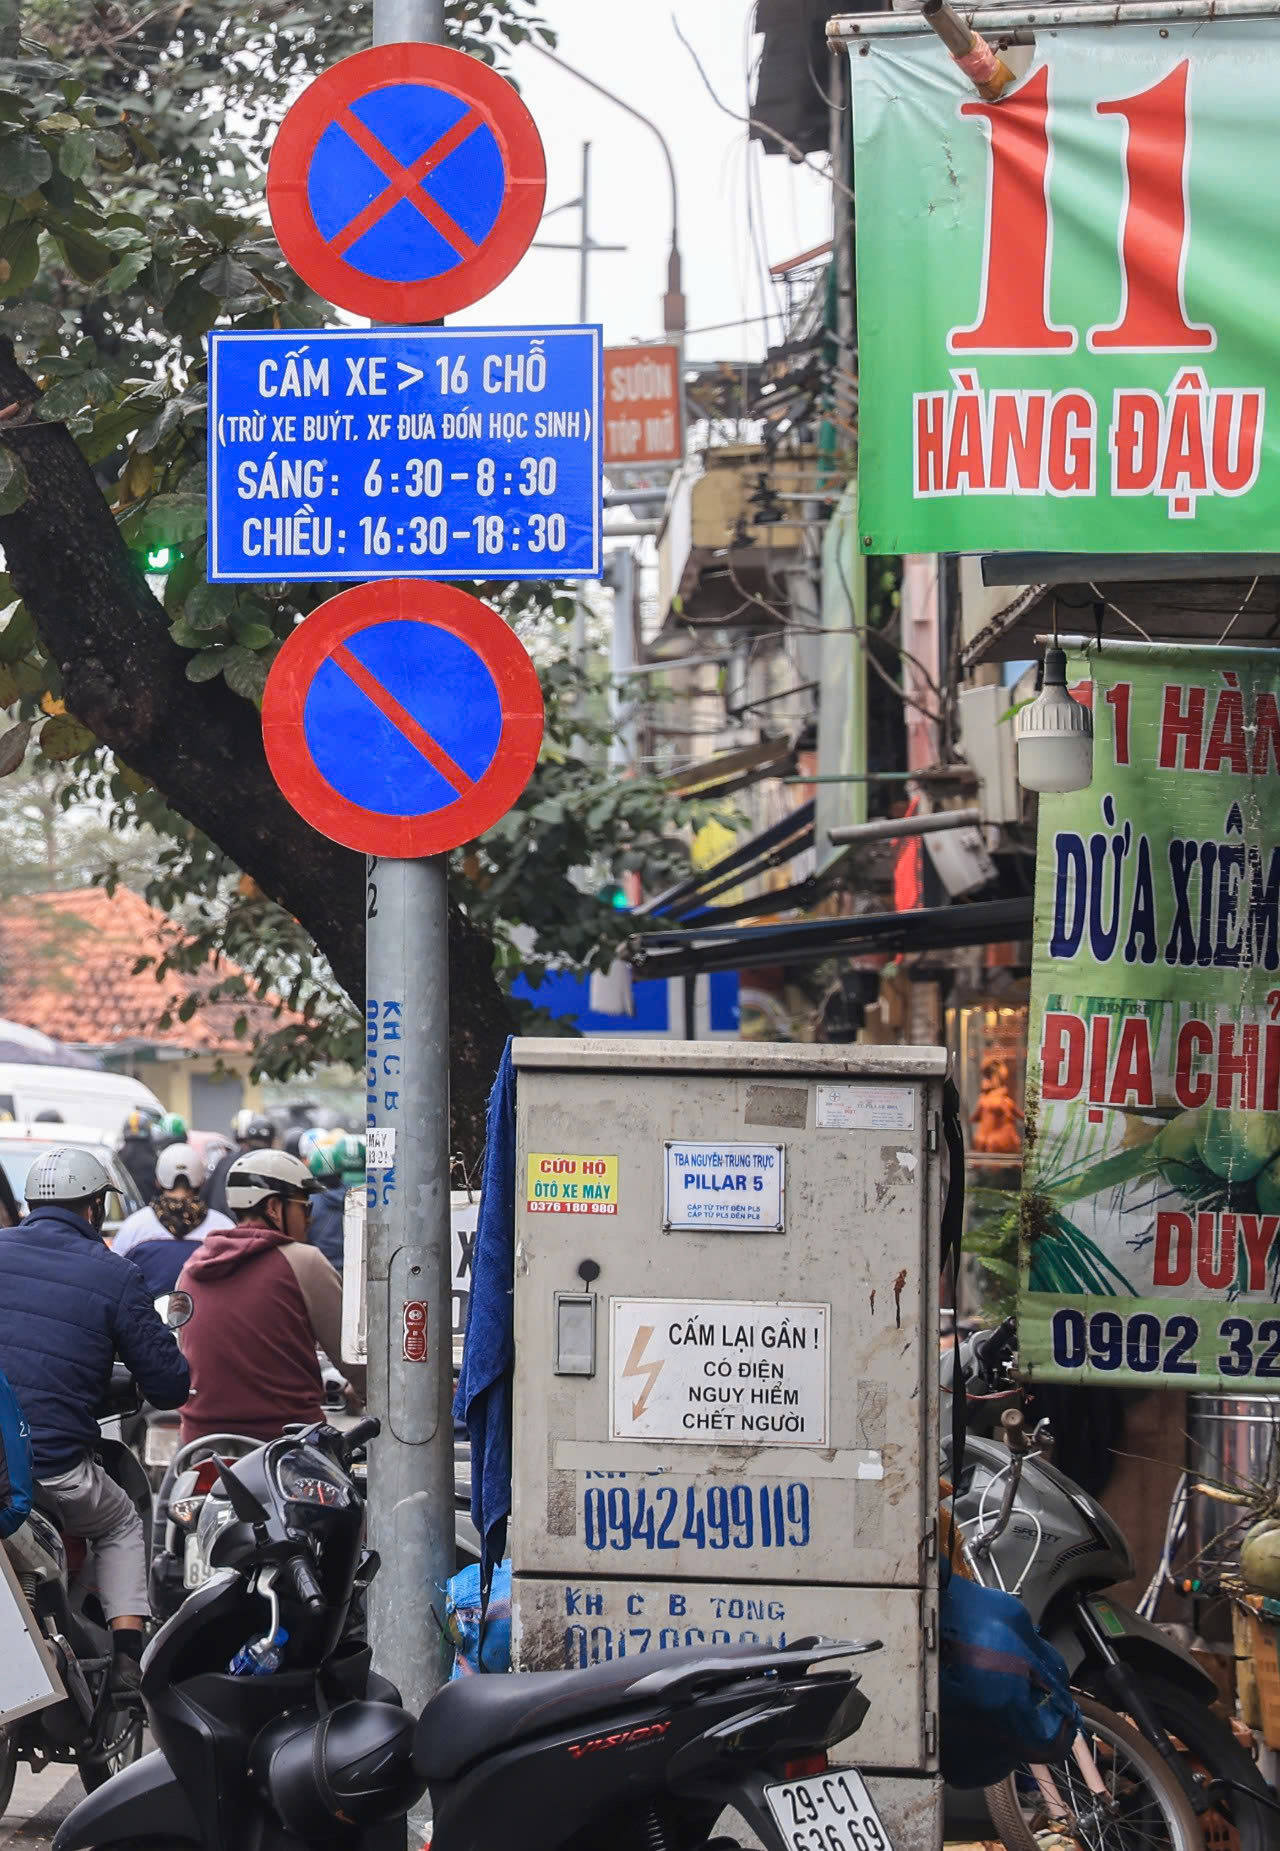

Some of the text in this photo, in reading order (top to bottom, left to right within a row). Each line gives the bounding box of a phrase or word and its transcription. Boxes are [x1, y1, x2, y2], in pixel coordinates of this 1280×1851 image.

[948, 61, 1215, 352] 11
[258, 345, 330, 398] CẤM
[345, 356, 388, 397] XE
[435, 355, 469, 395] 16
[482, 339, 547, 394] CHỖ
[218, 409, 267, 448] (TRỪ
[270, 415, 297, 443] XE
[396, 412, 436, 441] ĐƯA
[441, 406, 482, 440] ĐÓN
[488, 412, 528, 443] HỌC
[534, 408, 591, 442] SINH)
[915, 366, 1266, 519] HÀNG ĐẬU
[237, 453, 339, 500] SÁNG:
[241, 503, 346, 557] CHIỀU:
[1050, 795, 1158, 962] DỪA
[1041, 1014, 1154, 1123] ĐỊA
[540, 1157, 607, 1177] CỨU HỘ
[674, 1152, 690, 1166] TBA
[724, 1154, 751, 1168] TRUNG
[753, 1154, 774, 1171] TRỰC
[684, 1174, 764, 1192] PILLAR 5
[530, 1201, 616, 1214] 0376 180 980
[535, 1180, 611, 1199] ÔTÔ XE MÁY
[1153, 1211, 1280, 1291] DUY
[669, 1315, 715, 1346] CẤM
[722, 1325, 754, 1353] LẠI
[761, 1317, 806, 1350] GẦN
[1052, 1309, 1280, 1378] 0902 32
[703, 1357, 784, 1383] CÓ ĐIỆN
[688, 1380, 799, 1405] NGUY HIỂM
[682, 1408, 805, 1432] CHẾT NGƯỜI
[583, 1482, 810, 1551] 0942499119
[565, 1586, 786, 1621] KH C B TONG
[782, 1775, 858, 1825] 29-C1
